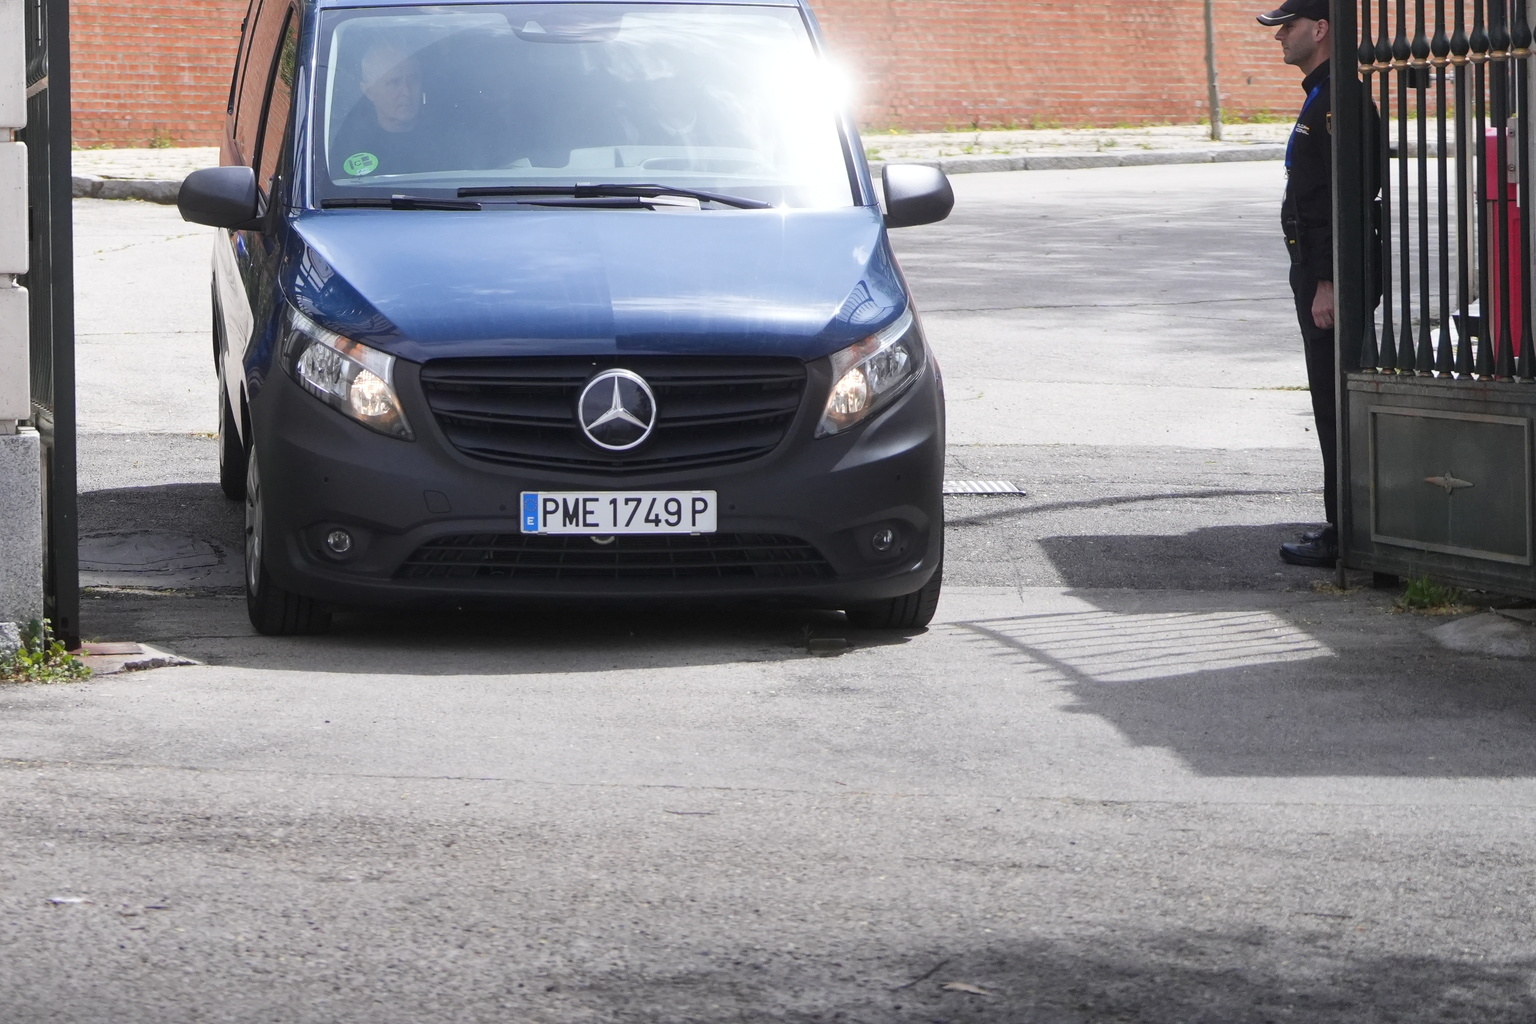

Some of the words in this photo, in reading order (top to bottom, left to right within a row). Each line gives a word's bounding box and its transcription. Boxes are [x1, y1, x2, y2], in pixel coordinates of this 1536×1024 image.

[527, 516, 534, 525] E
[542, 497, 600, 528] PME
[609, 497, 682, 528] 1749
[691, 497, 709, 527] P
